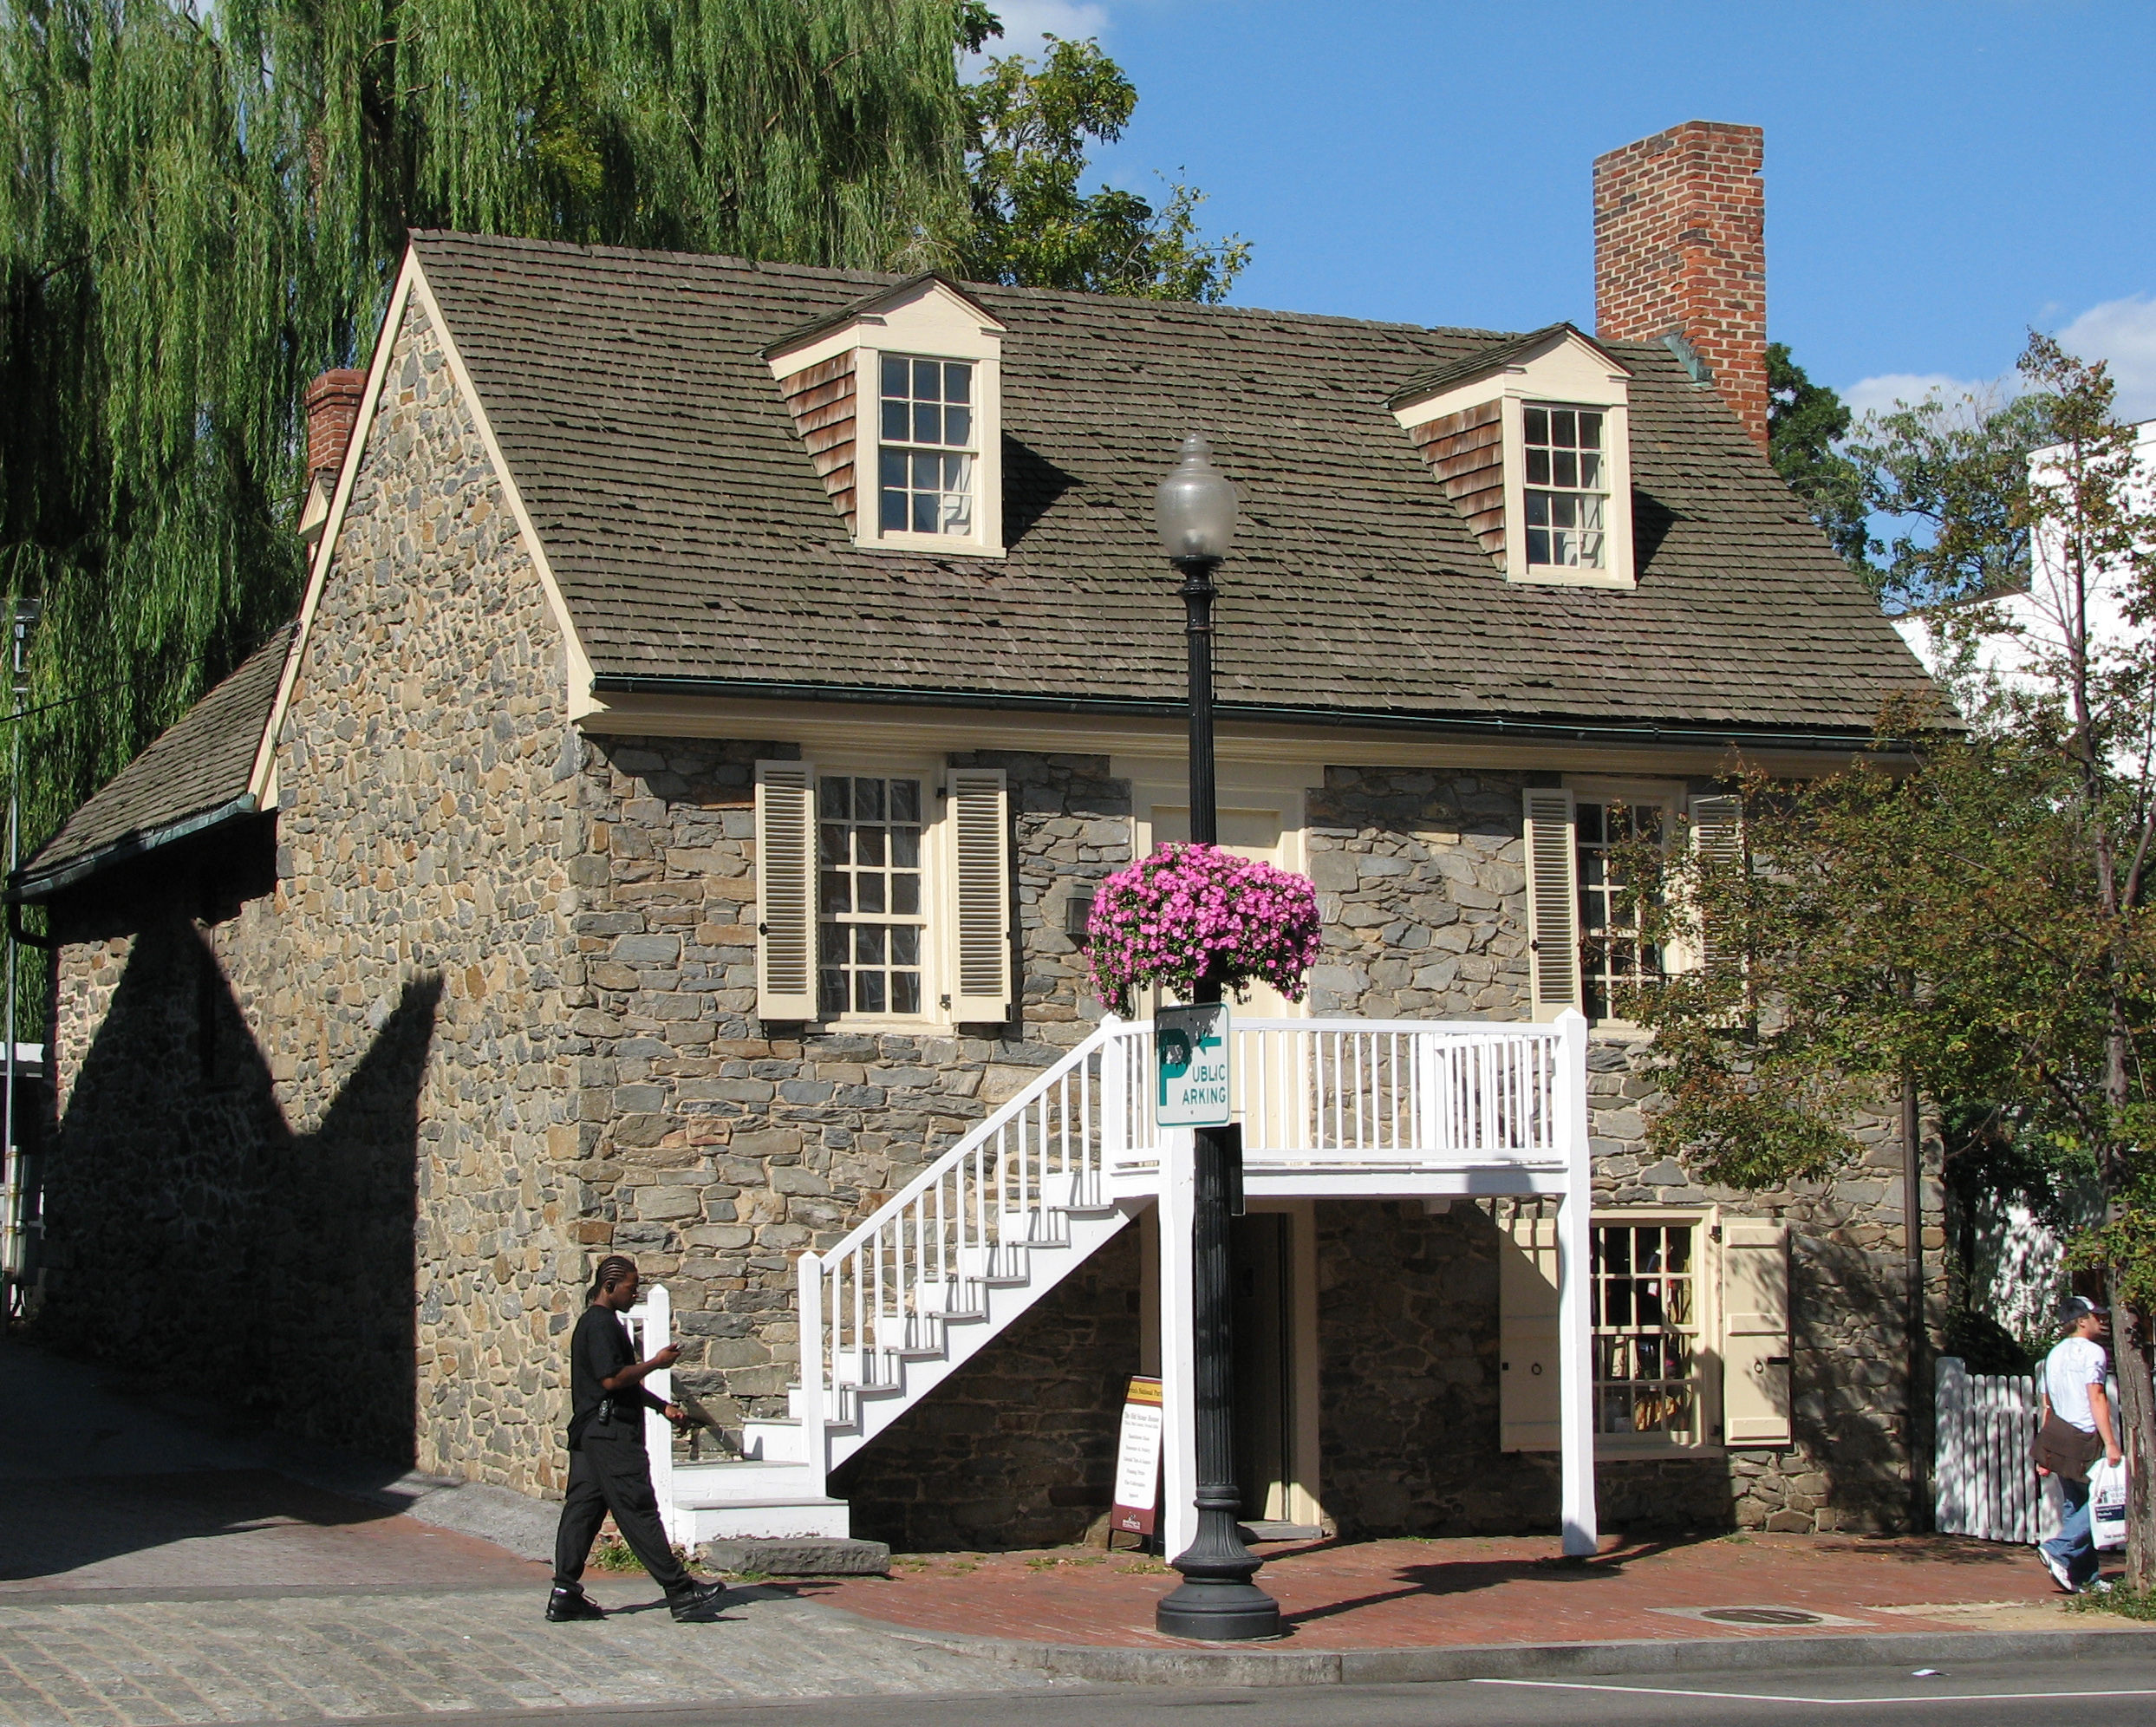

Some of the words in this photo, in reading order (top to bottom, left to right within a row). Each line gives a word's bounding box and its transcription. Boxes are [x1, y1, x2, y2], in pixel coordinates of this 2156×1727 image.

[1159, 1028, 1191, 1106] P
[1192, 1064, 1226, 1083] UBLIC
[1182, 1086, 1226, 1105] ARKING
